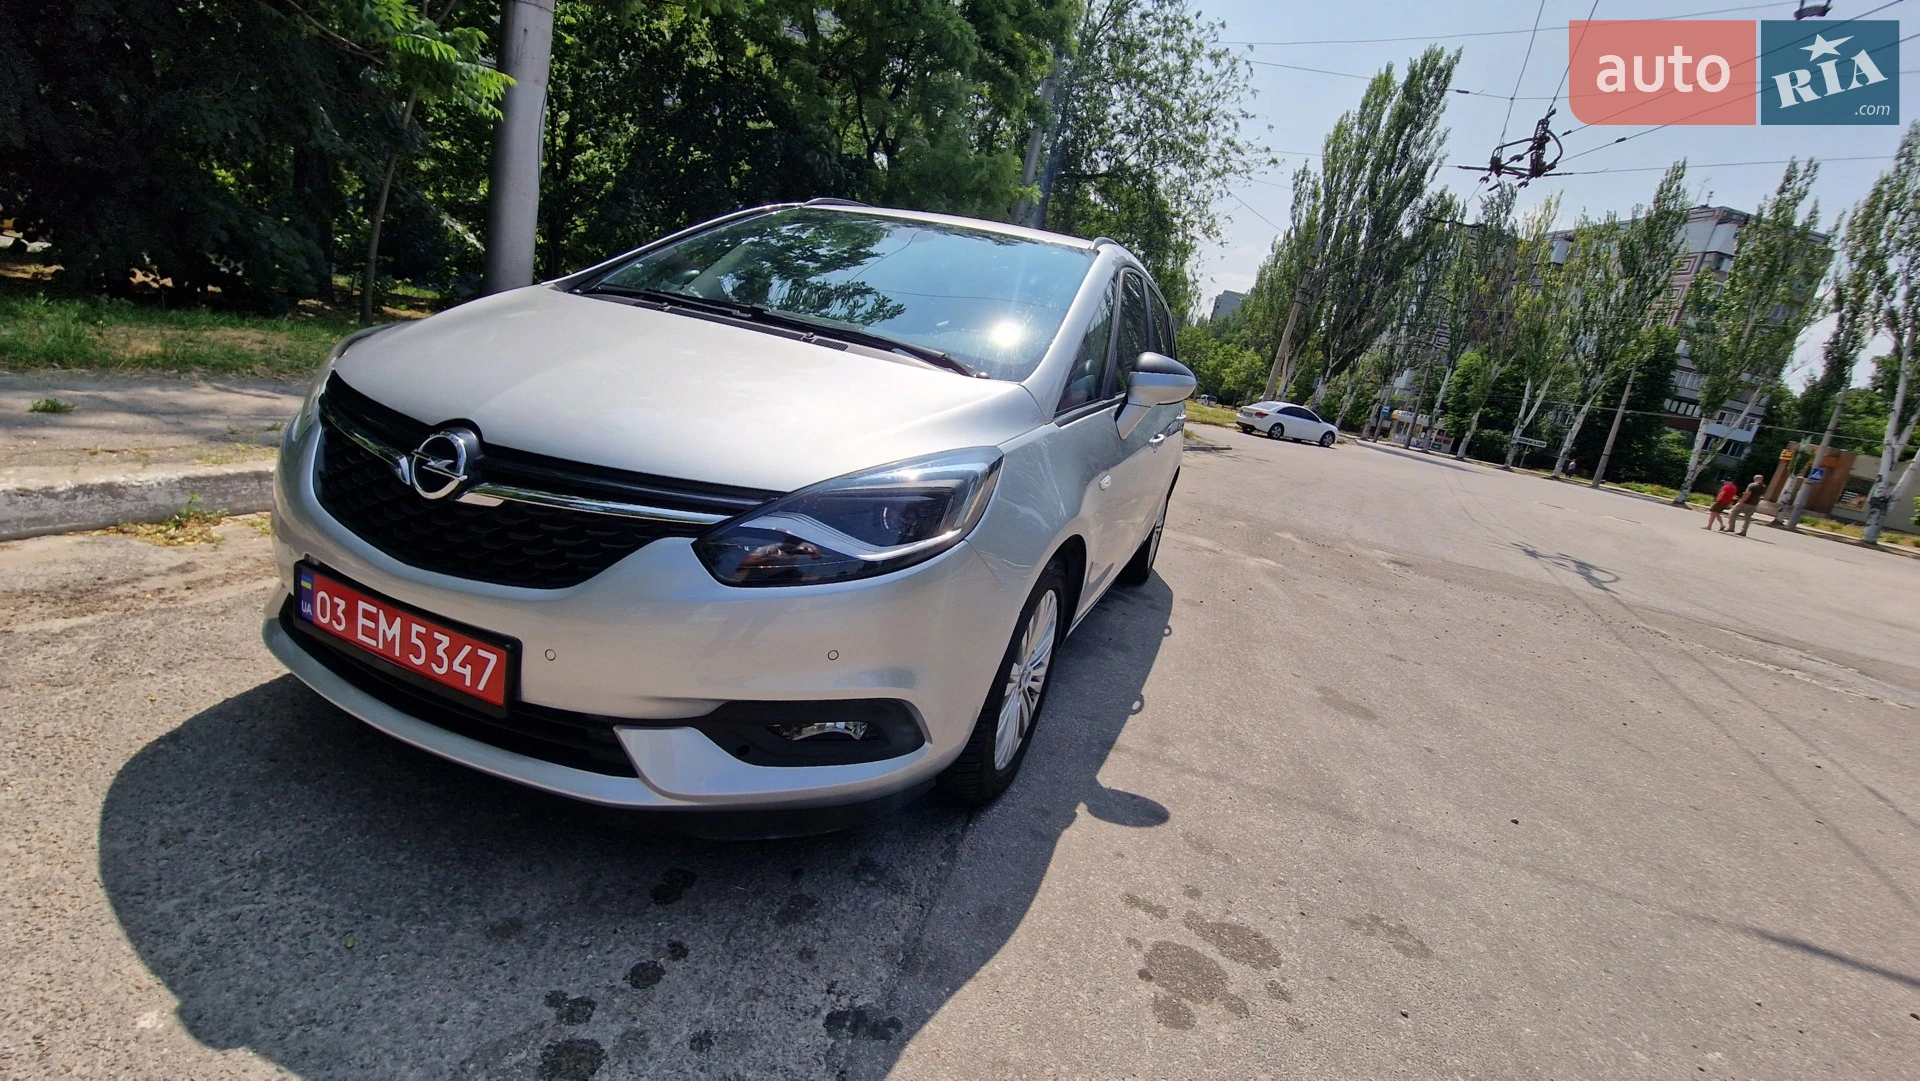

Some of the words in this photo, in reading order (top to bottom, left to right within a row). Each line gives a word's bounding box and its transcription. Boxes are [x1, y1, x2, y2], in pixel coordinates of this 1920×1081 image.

[301, 601, 313, 616] UA
[316, 591, 346, 632] 03
[357, 600, 402, 657] EM
[408, 622, 498, 691] 5347
